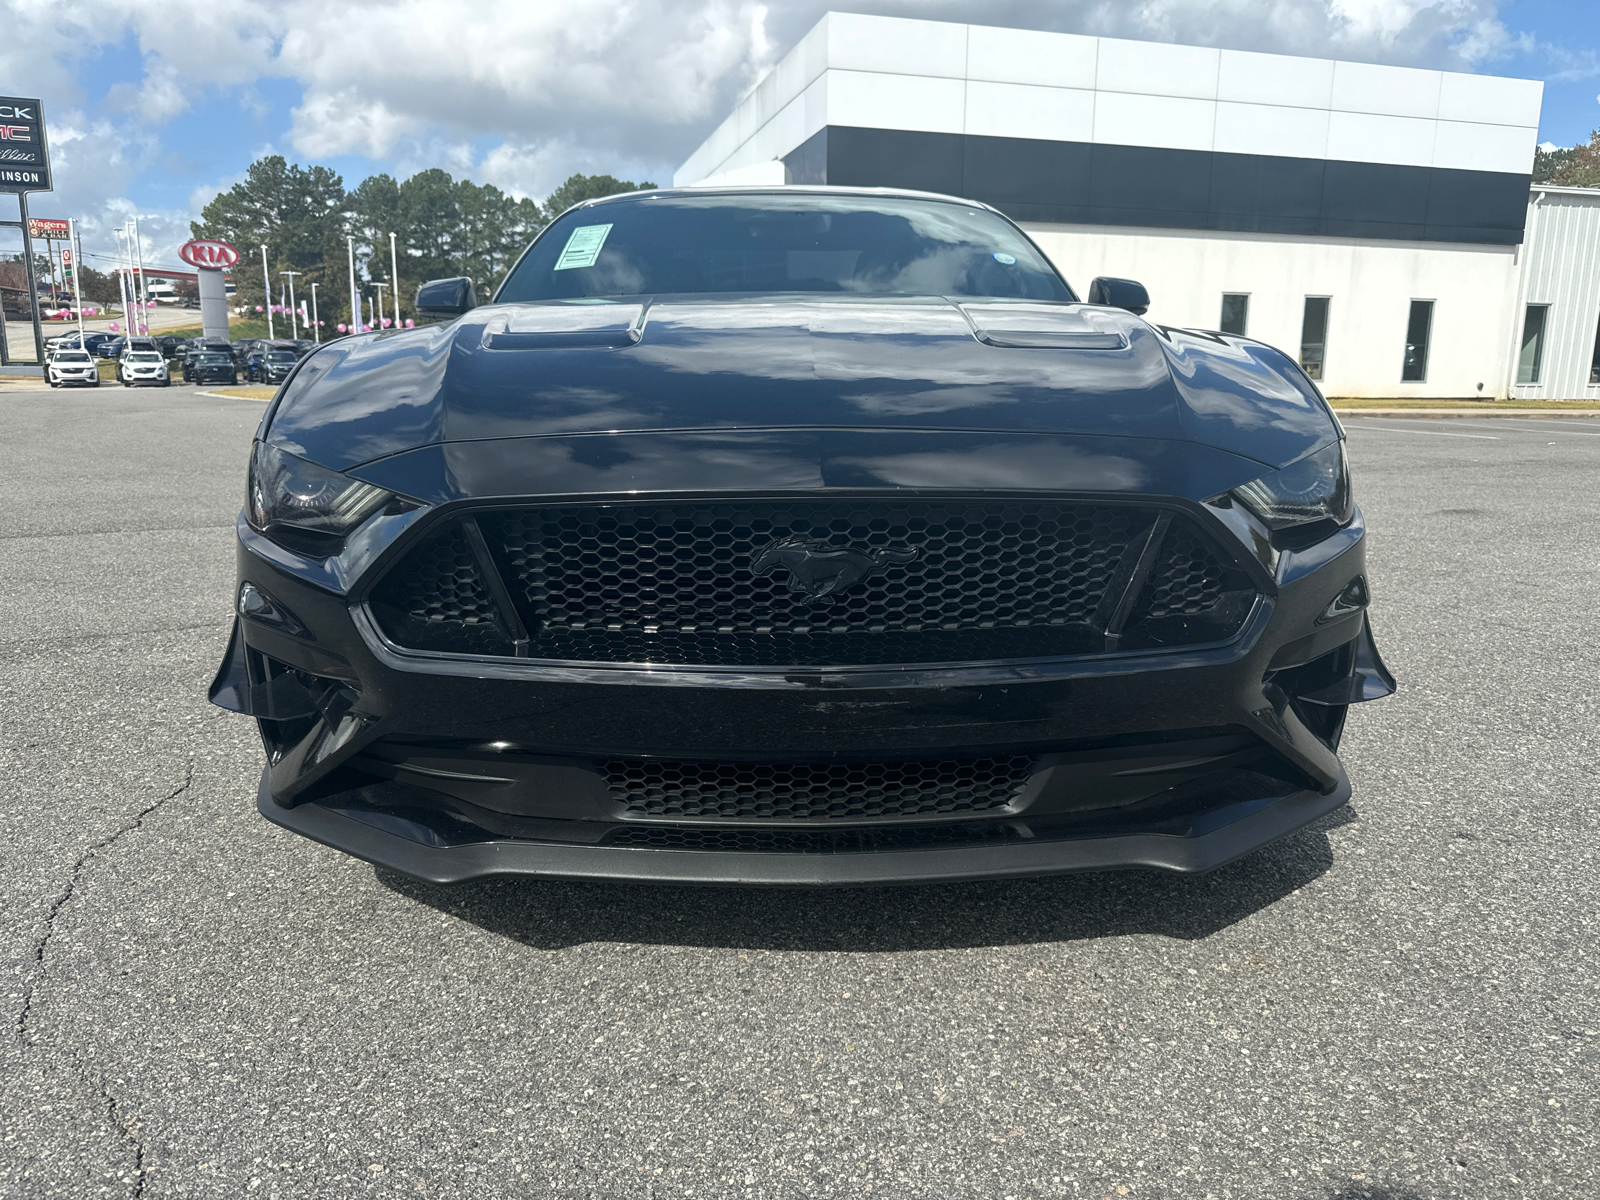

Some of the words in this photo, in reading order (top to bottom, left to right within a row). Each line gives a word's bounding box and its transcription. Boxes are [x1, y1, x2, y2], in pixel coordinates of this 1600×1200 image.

[1, 171, 39, 183] INSON
[28, 219, 67, 229] Wagers
[191, 245, 231, 264] KIA
